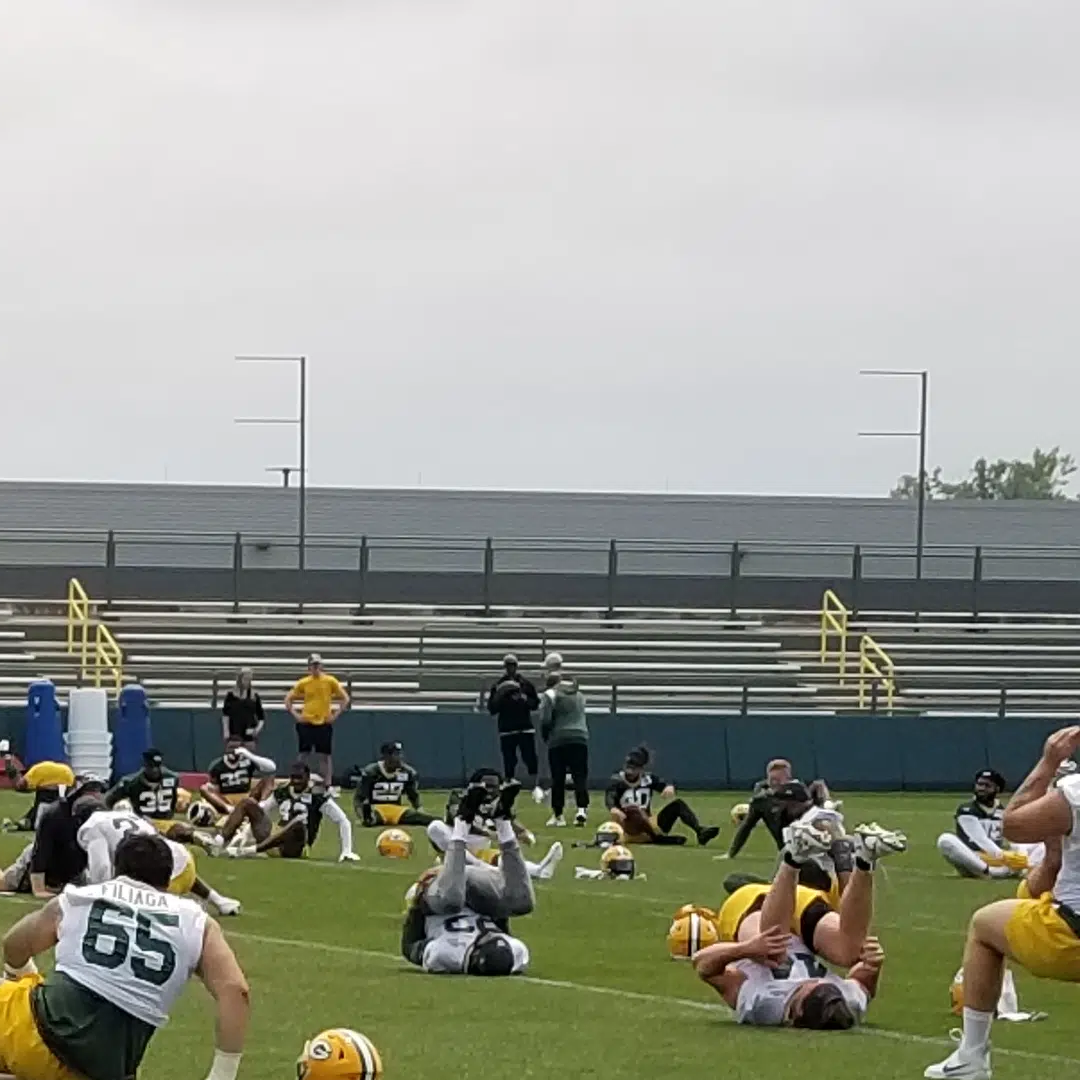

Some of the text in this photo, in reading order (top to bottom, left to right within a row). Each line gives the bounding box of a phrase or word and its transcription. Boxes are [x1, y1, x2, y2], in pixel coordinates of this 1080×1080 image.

[139, 788, 173, 812] 35
[102, 884, 169, 908] FILIAGA
[82, 898, 180, 986] 65
